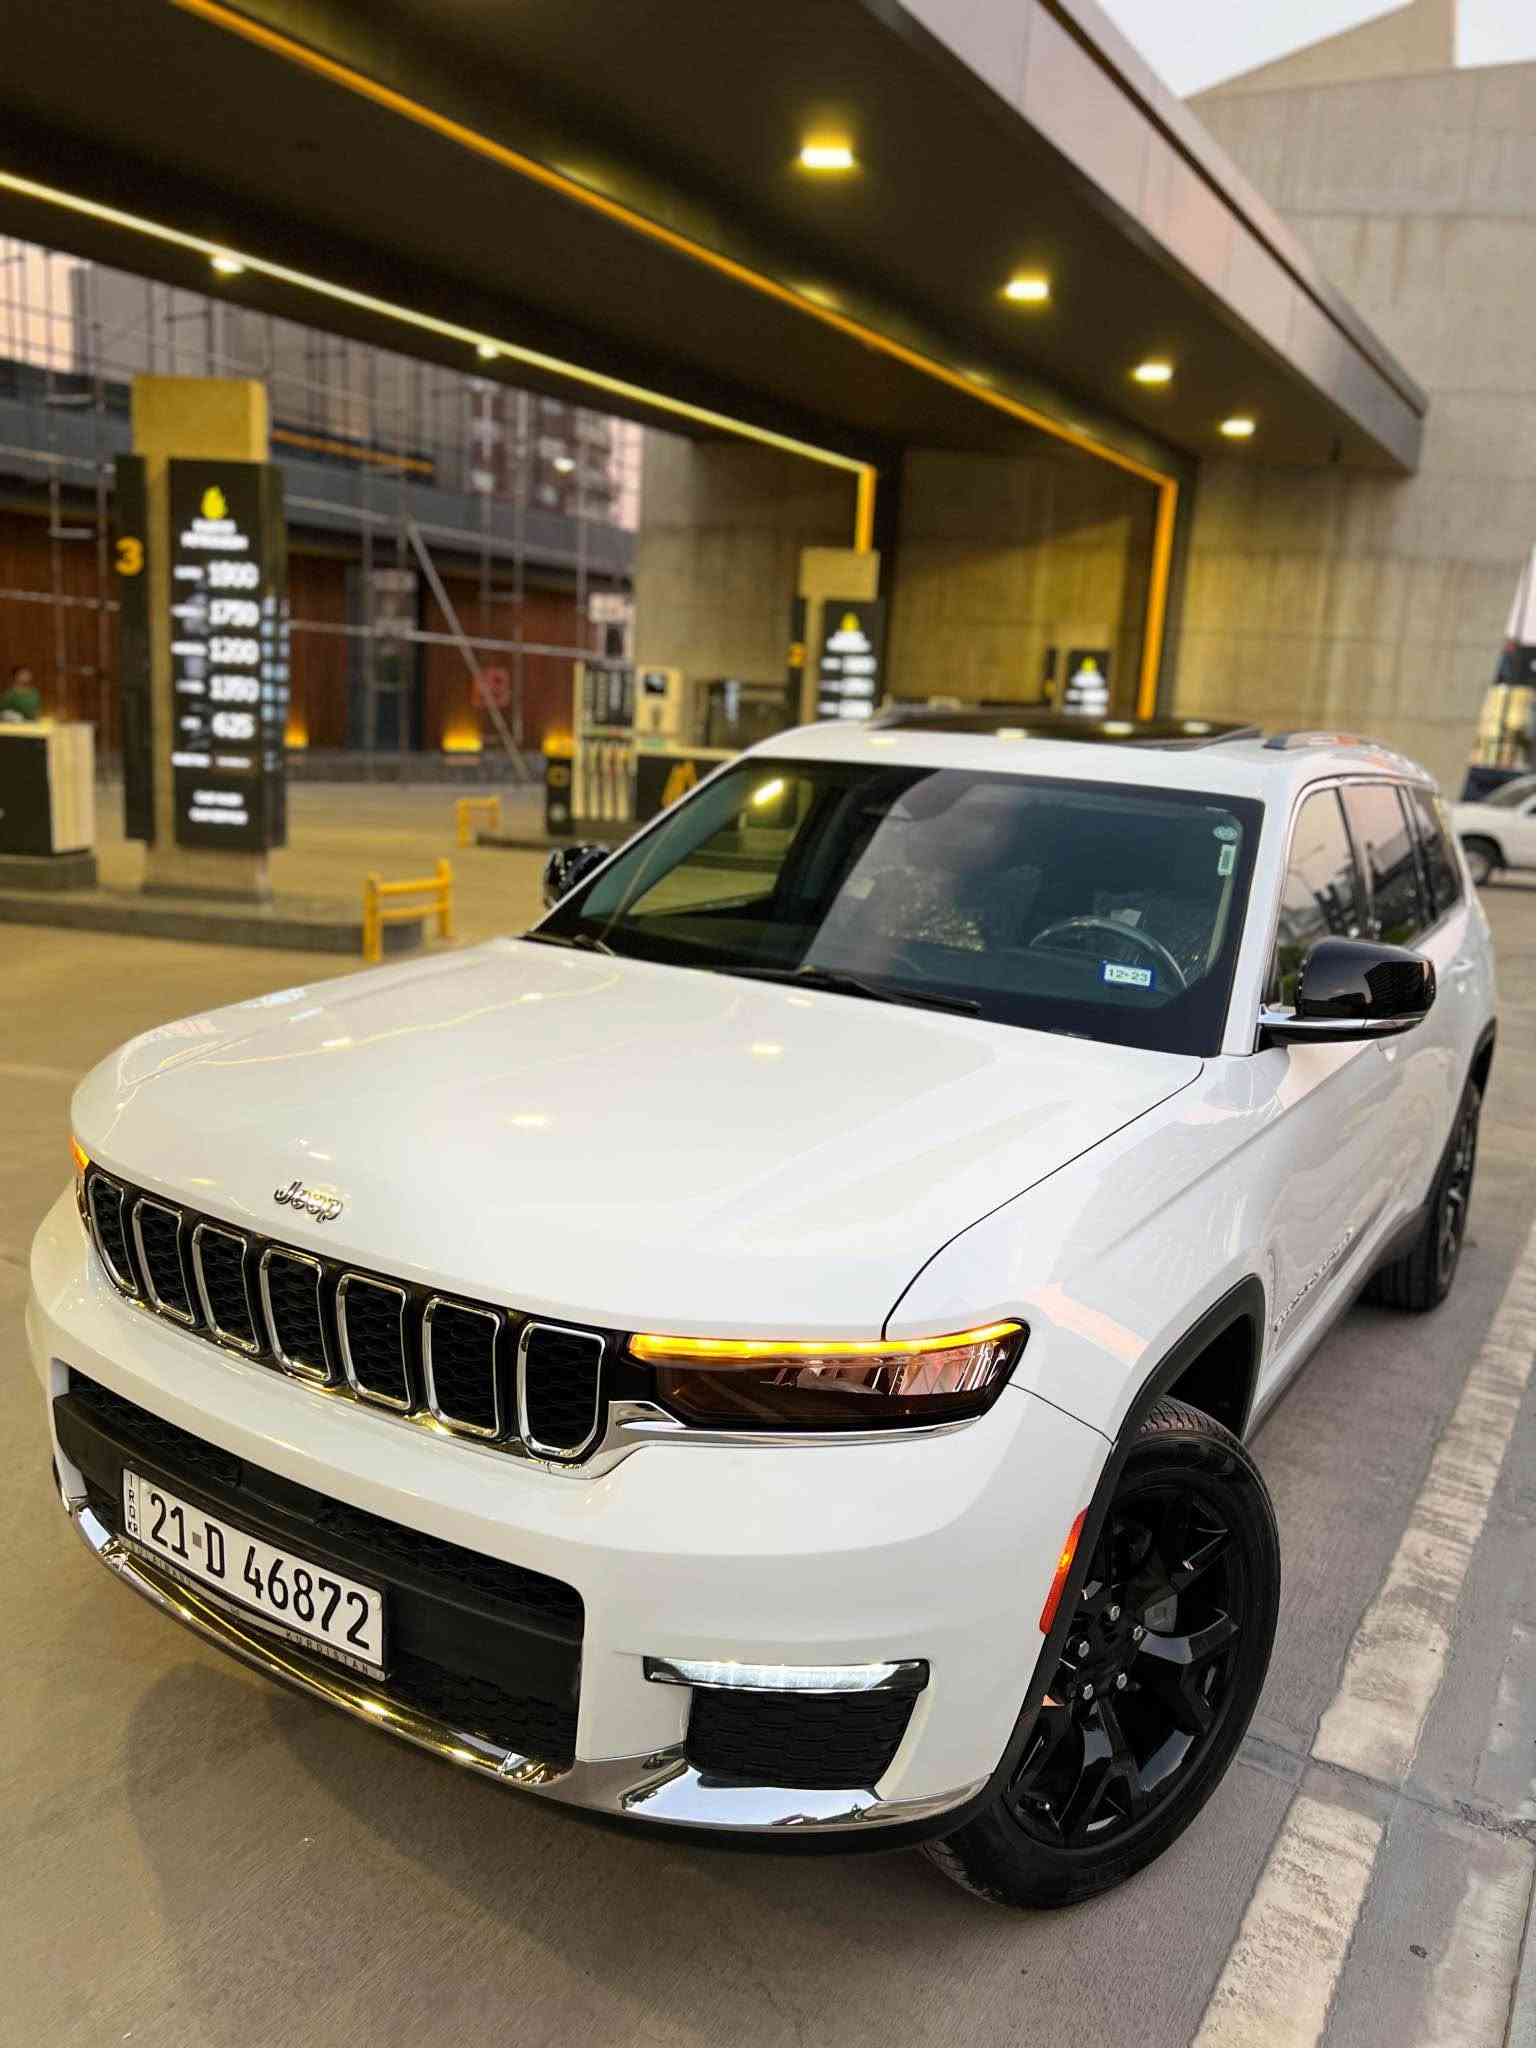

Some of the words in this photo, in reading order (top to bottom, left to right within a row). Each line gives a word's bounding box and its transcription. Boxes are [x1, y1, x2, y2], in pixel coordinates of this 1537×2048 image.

[115, 536, 144, 576] 3
[274, 1181, 343, 1223] Jeep
[243, 1545, 370, 1650] 46872
